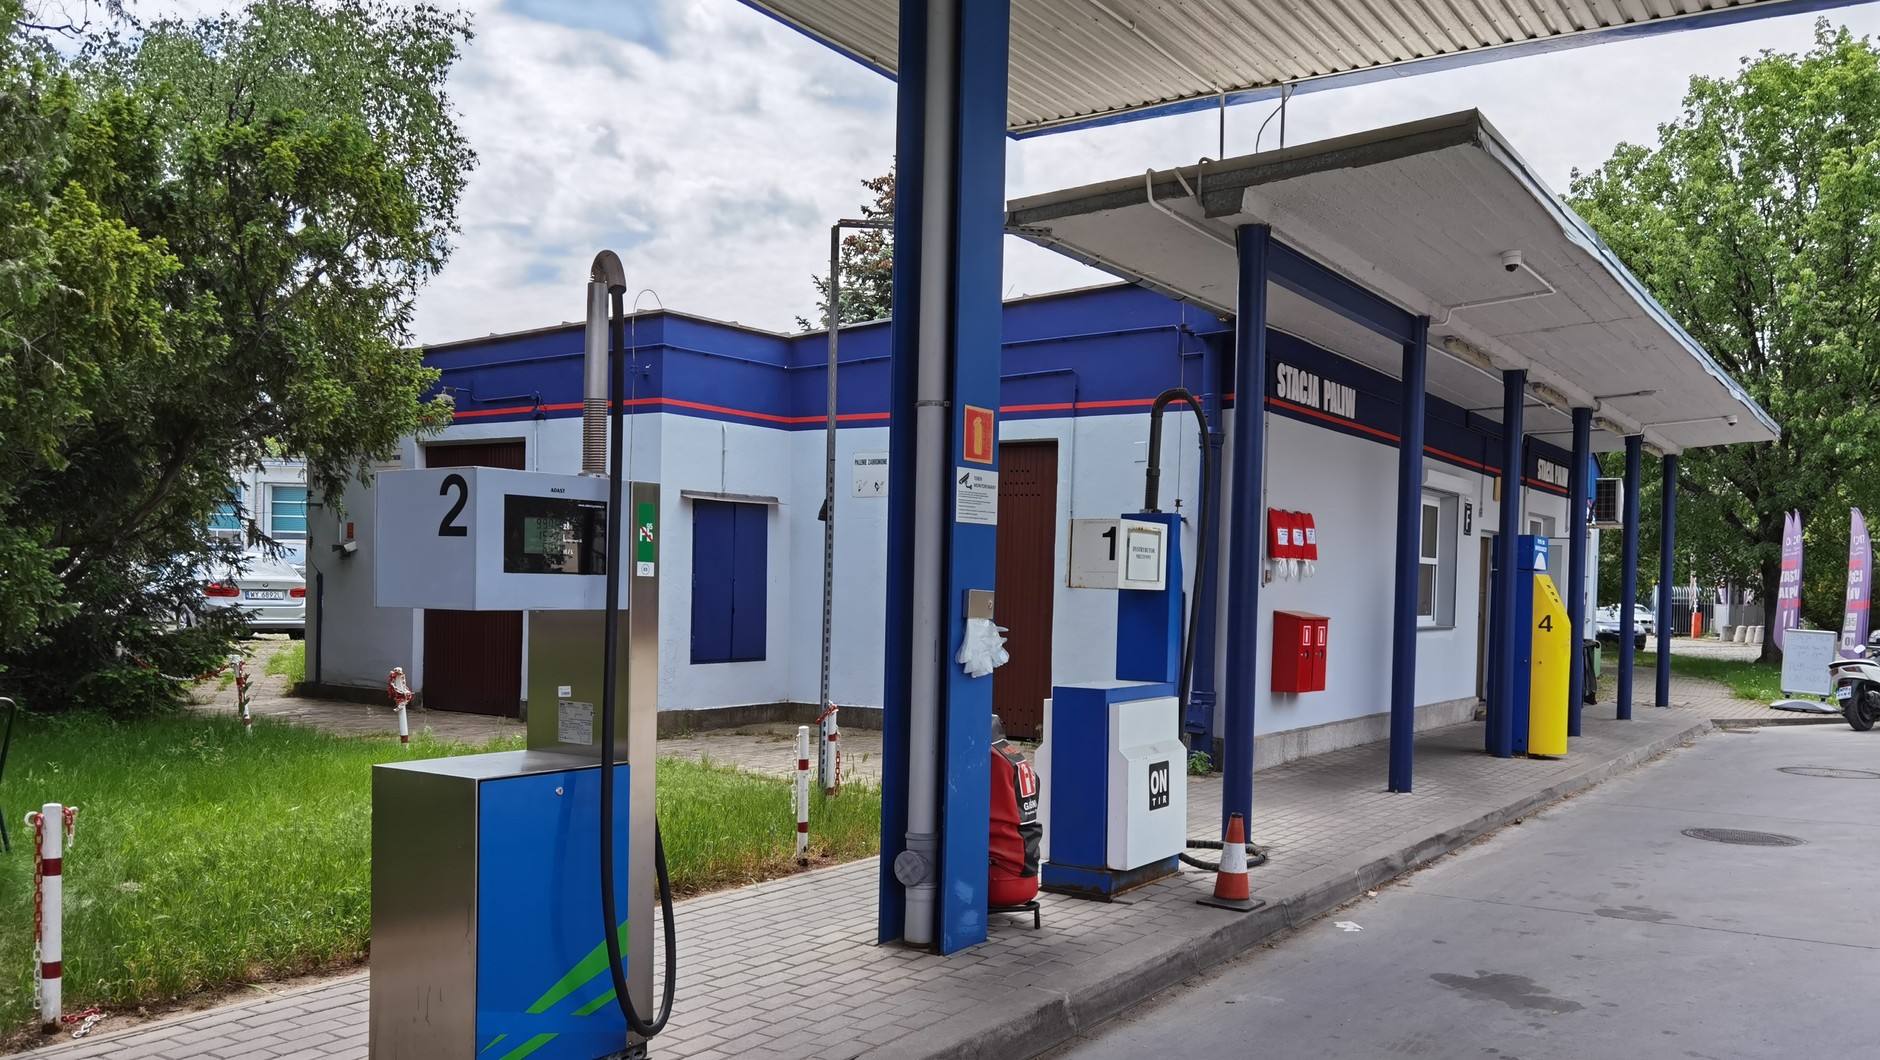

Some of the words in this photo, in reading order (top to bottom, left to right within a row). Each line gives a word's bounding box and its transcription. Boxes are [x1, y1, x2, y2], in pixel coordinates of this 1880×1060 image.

[1277, 362, 1320, 409] STACJA
[1323, 379, 1356, 419] PALIW
[438, 473, 469, 537] 2
[1102, 526, 1117, 561] 1
[1538, 614, 1553, 632] 4
[1150, 768, 1168, 795] ON
[1152, 795, 1167, 806] TIR
